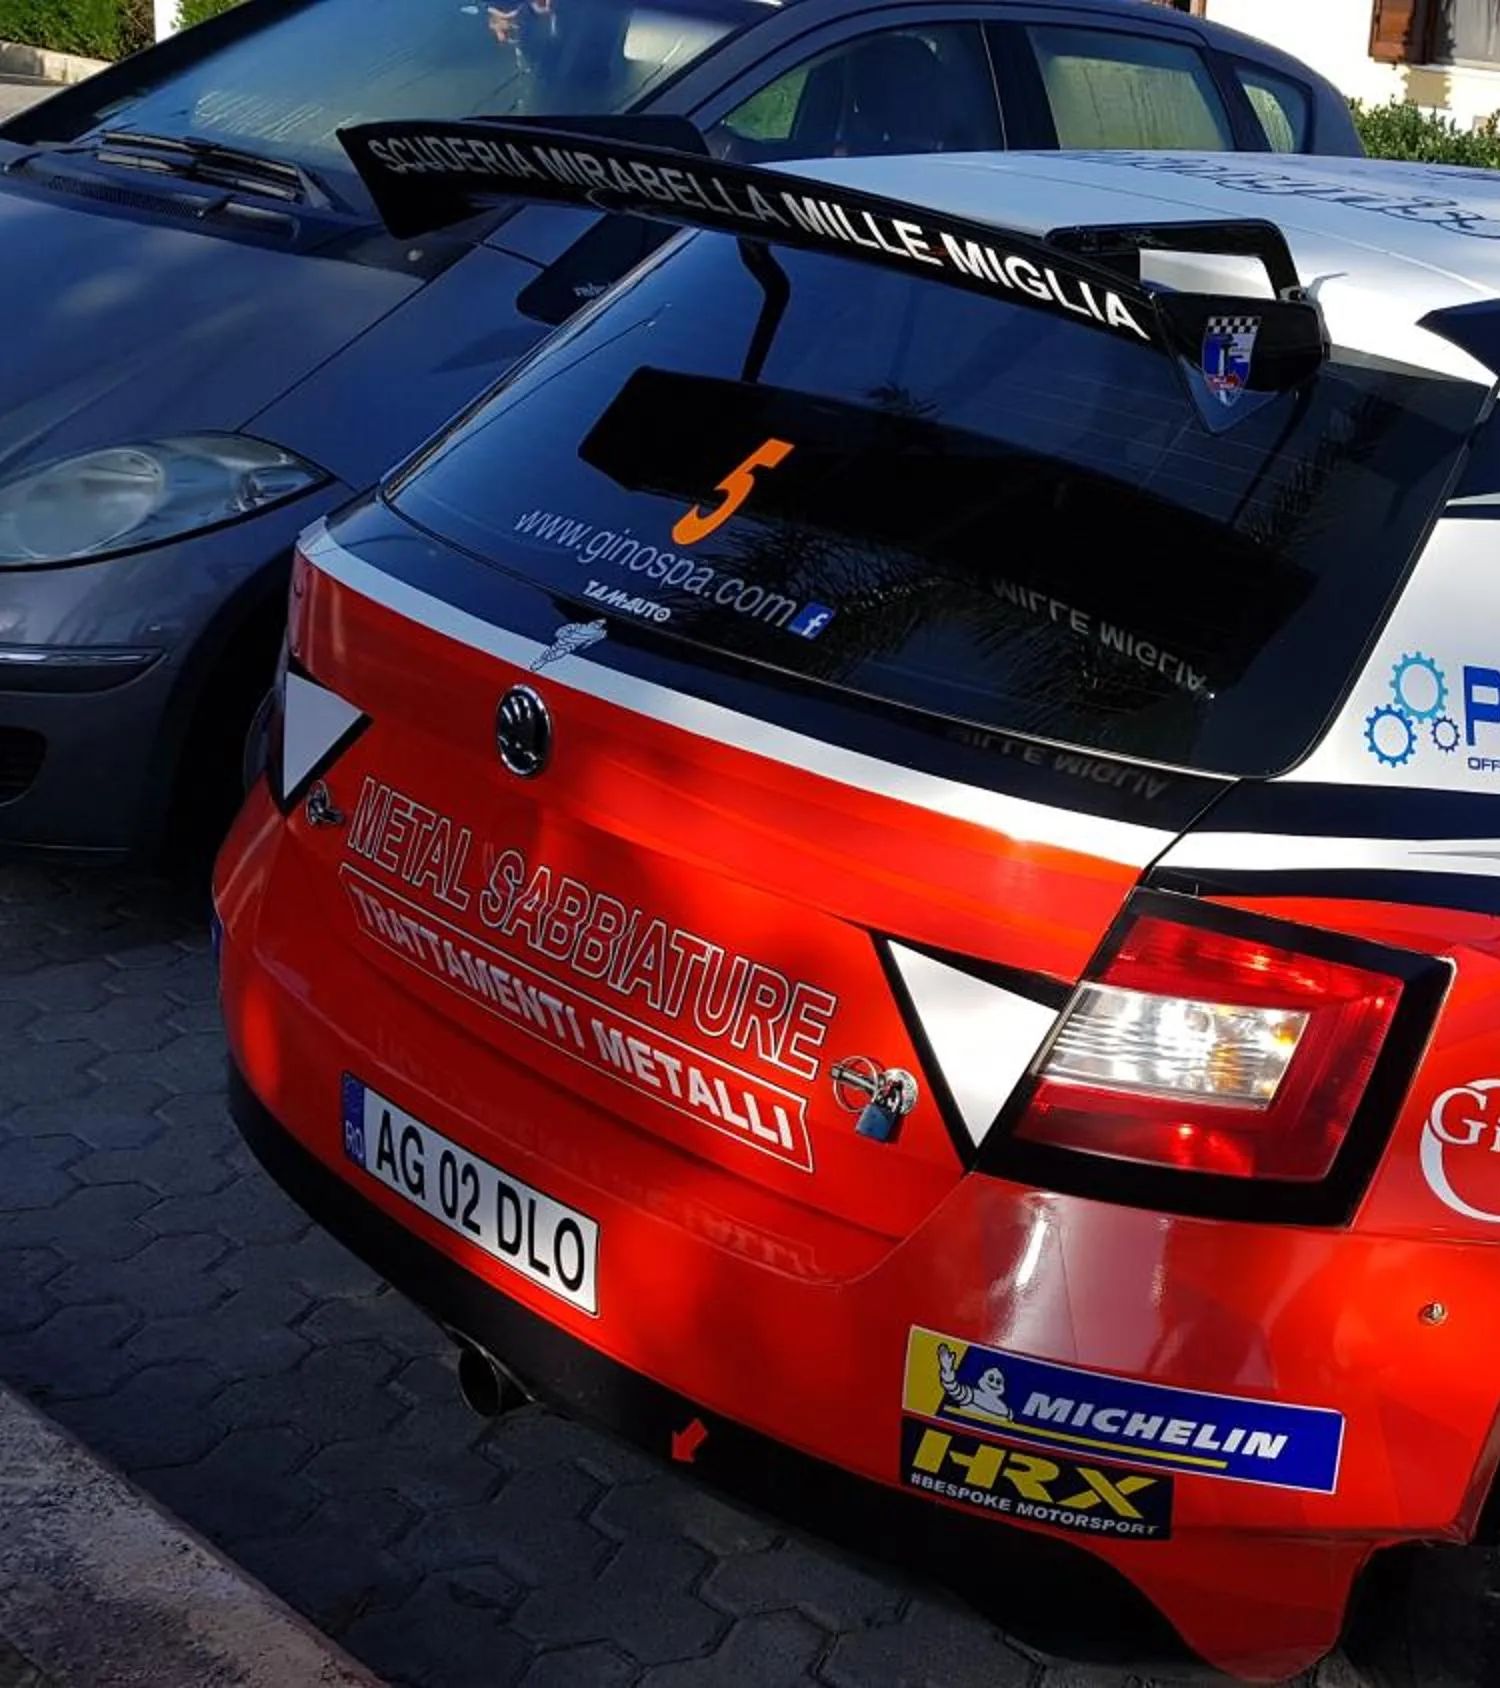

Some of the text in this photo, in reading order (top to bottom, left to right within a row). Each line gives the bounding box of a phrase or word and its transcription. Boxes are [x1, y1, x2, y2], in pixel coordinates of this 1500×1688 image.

[367, 136, 1151, 341] SCUDERIA MIRABELLA MILLE MIGLIA
[671, 437, 795, 545] 5
[513, 510, 798, 628] www.ginospa.com
[347, 775, 838, 1082] METAL SABBIATURE
[349, 883, 795, 1151] TRATTAMENTI METALLI
[345, 1119, 364, 1160] RO
[376, 1109, 426, 1201] AG
[438, 1149, 481, 1236] 02
[497, 1179, 586, 1292] DLO
[911, 1428, 1159, 1520] HRX
[1022, 1390, 1290, 1461] MICHELIN
[910, 1471, 1161, 1537] #BESPOKE MOTORSPORT
